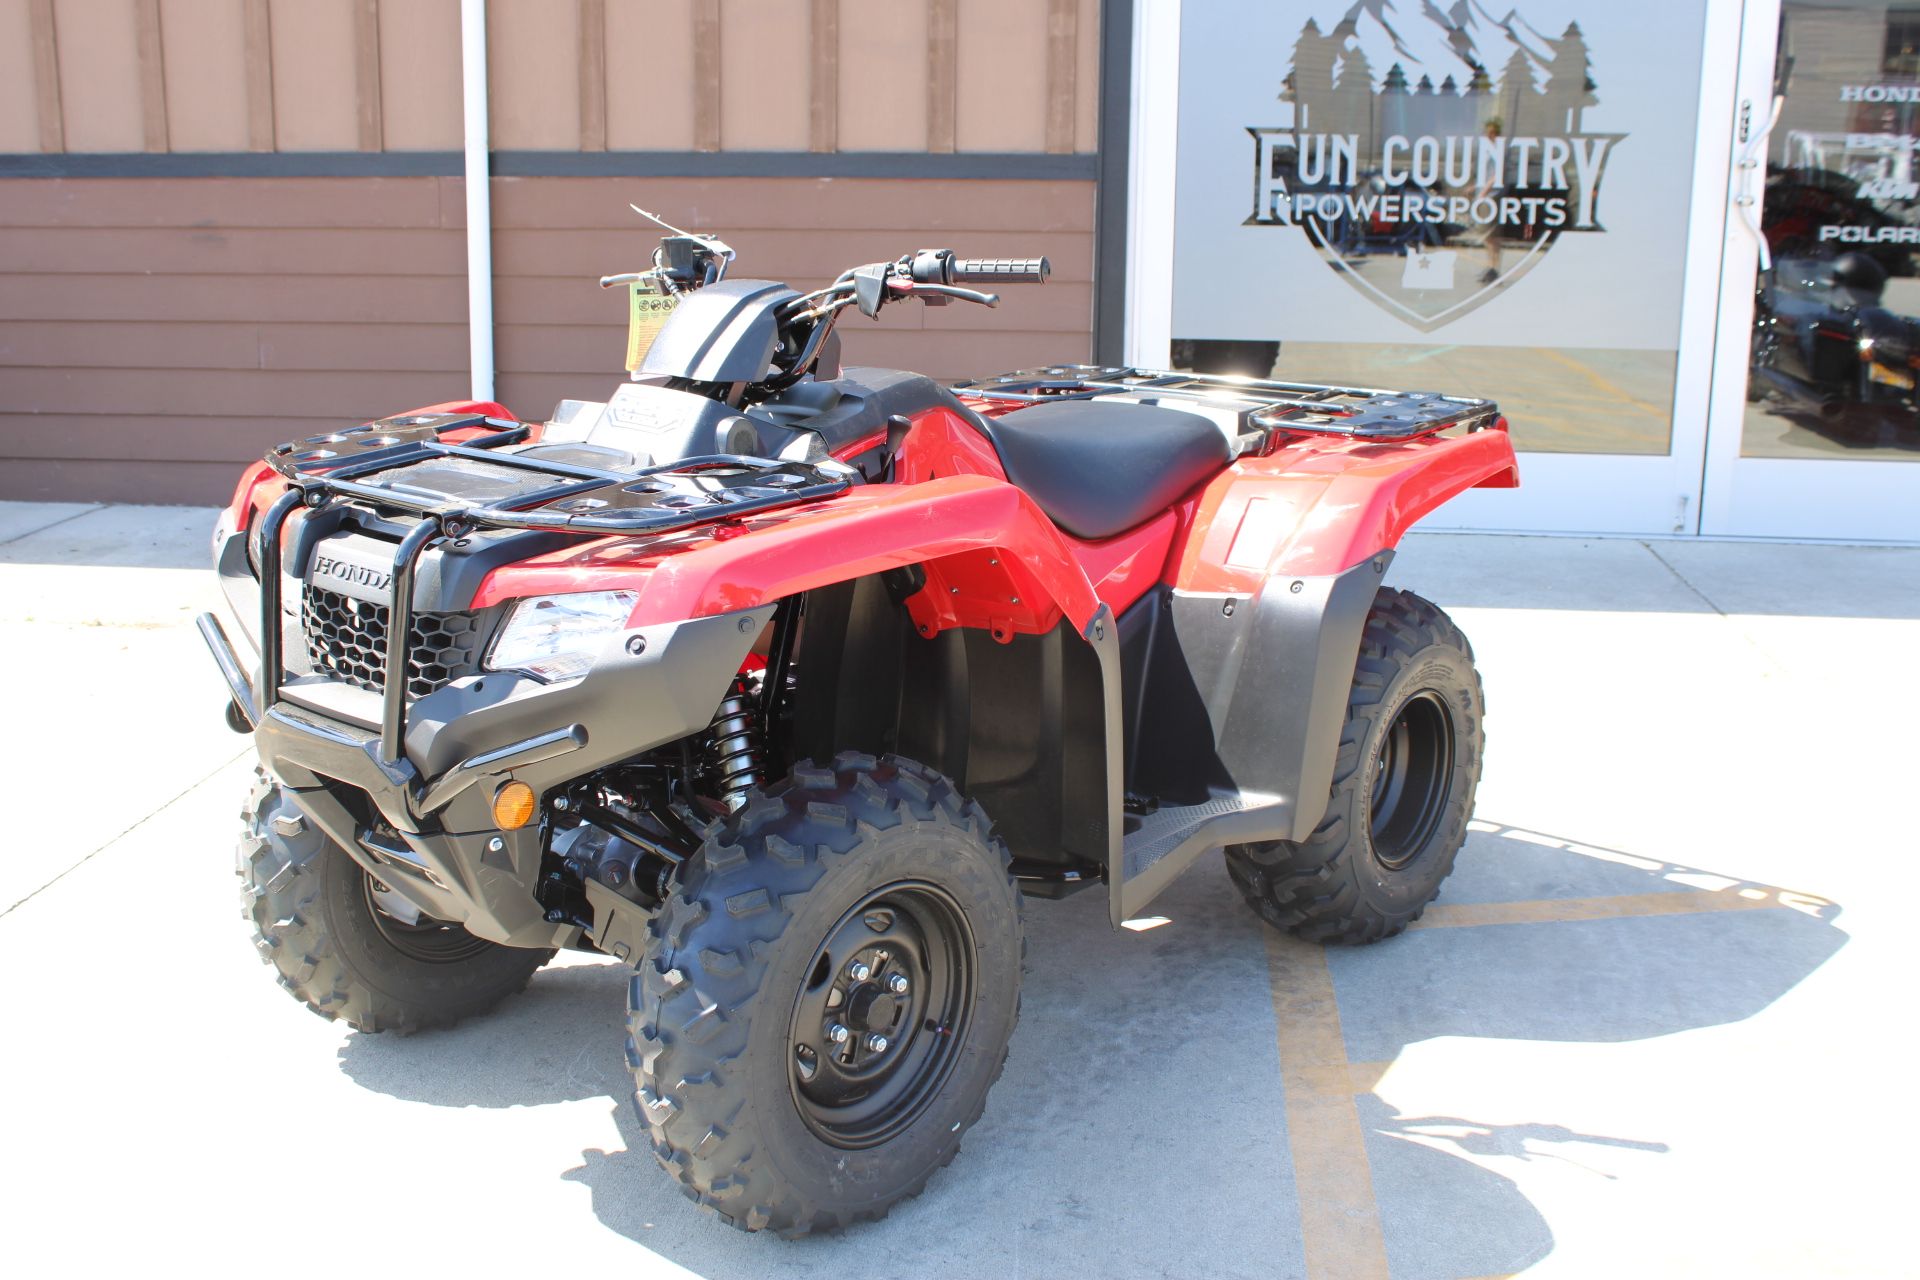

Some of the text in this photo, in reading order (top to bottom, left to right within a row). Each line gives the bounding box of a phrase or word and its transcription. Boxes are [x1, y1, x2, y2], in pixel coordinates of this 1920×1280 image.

[1256, 132, 1612, 228] FUN COUNTRY
[1295, 193, 1566, 226] POWERSPORTS
